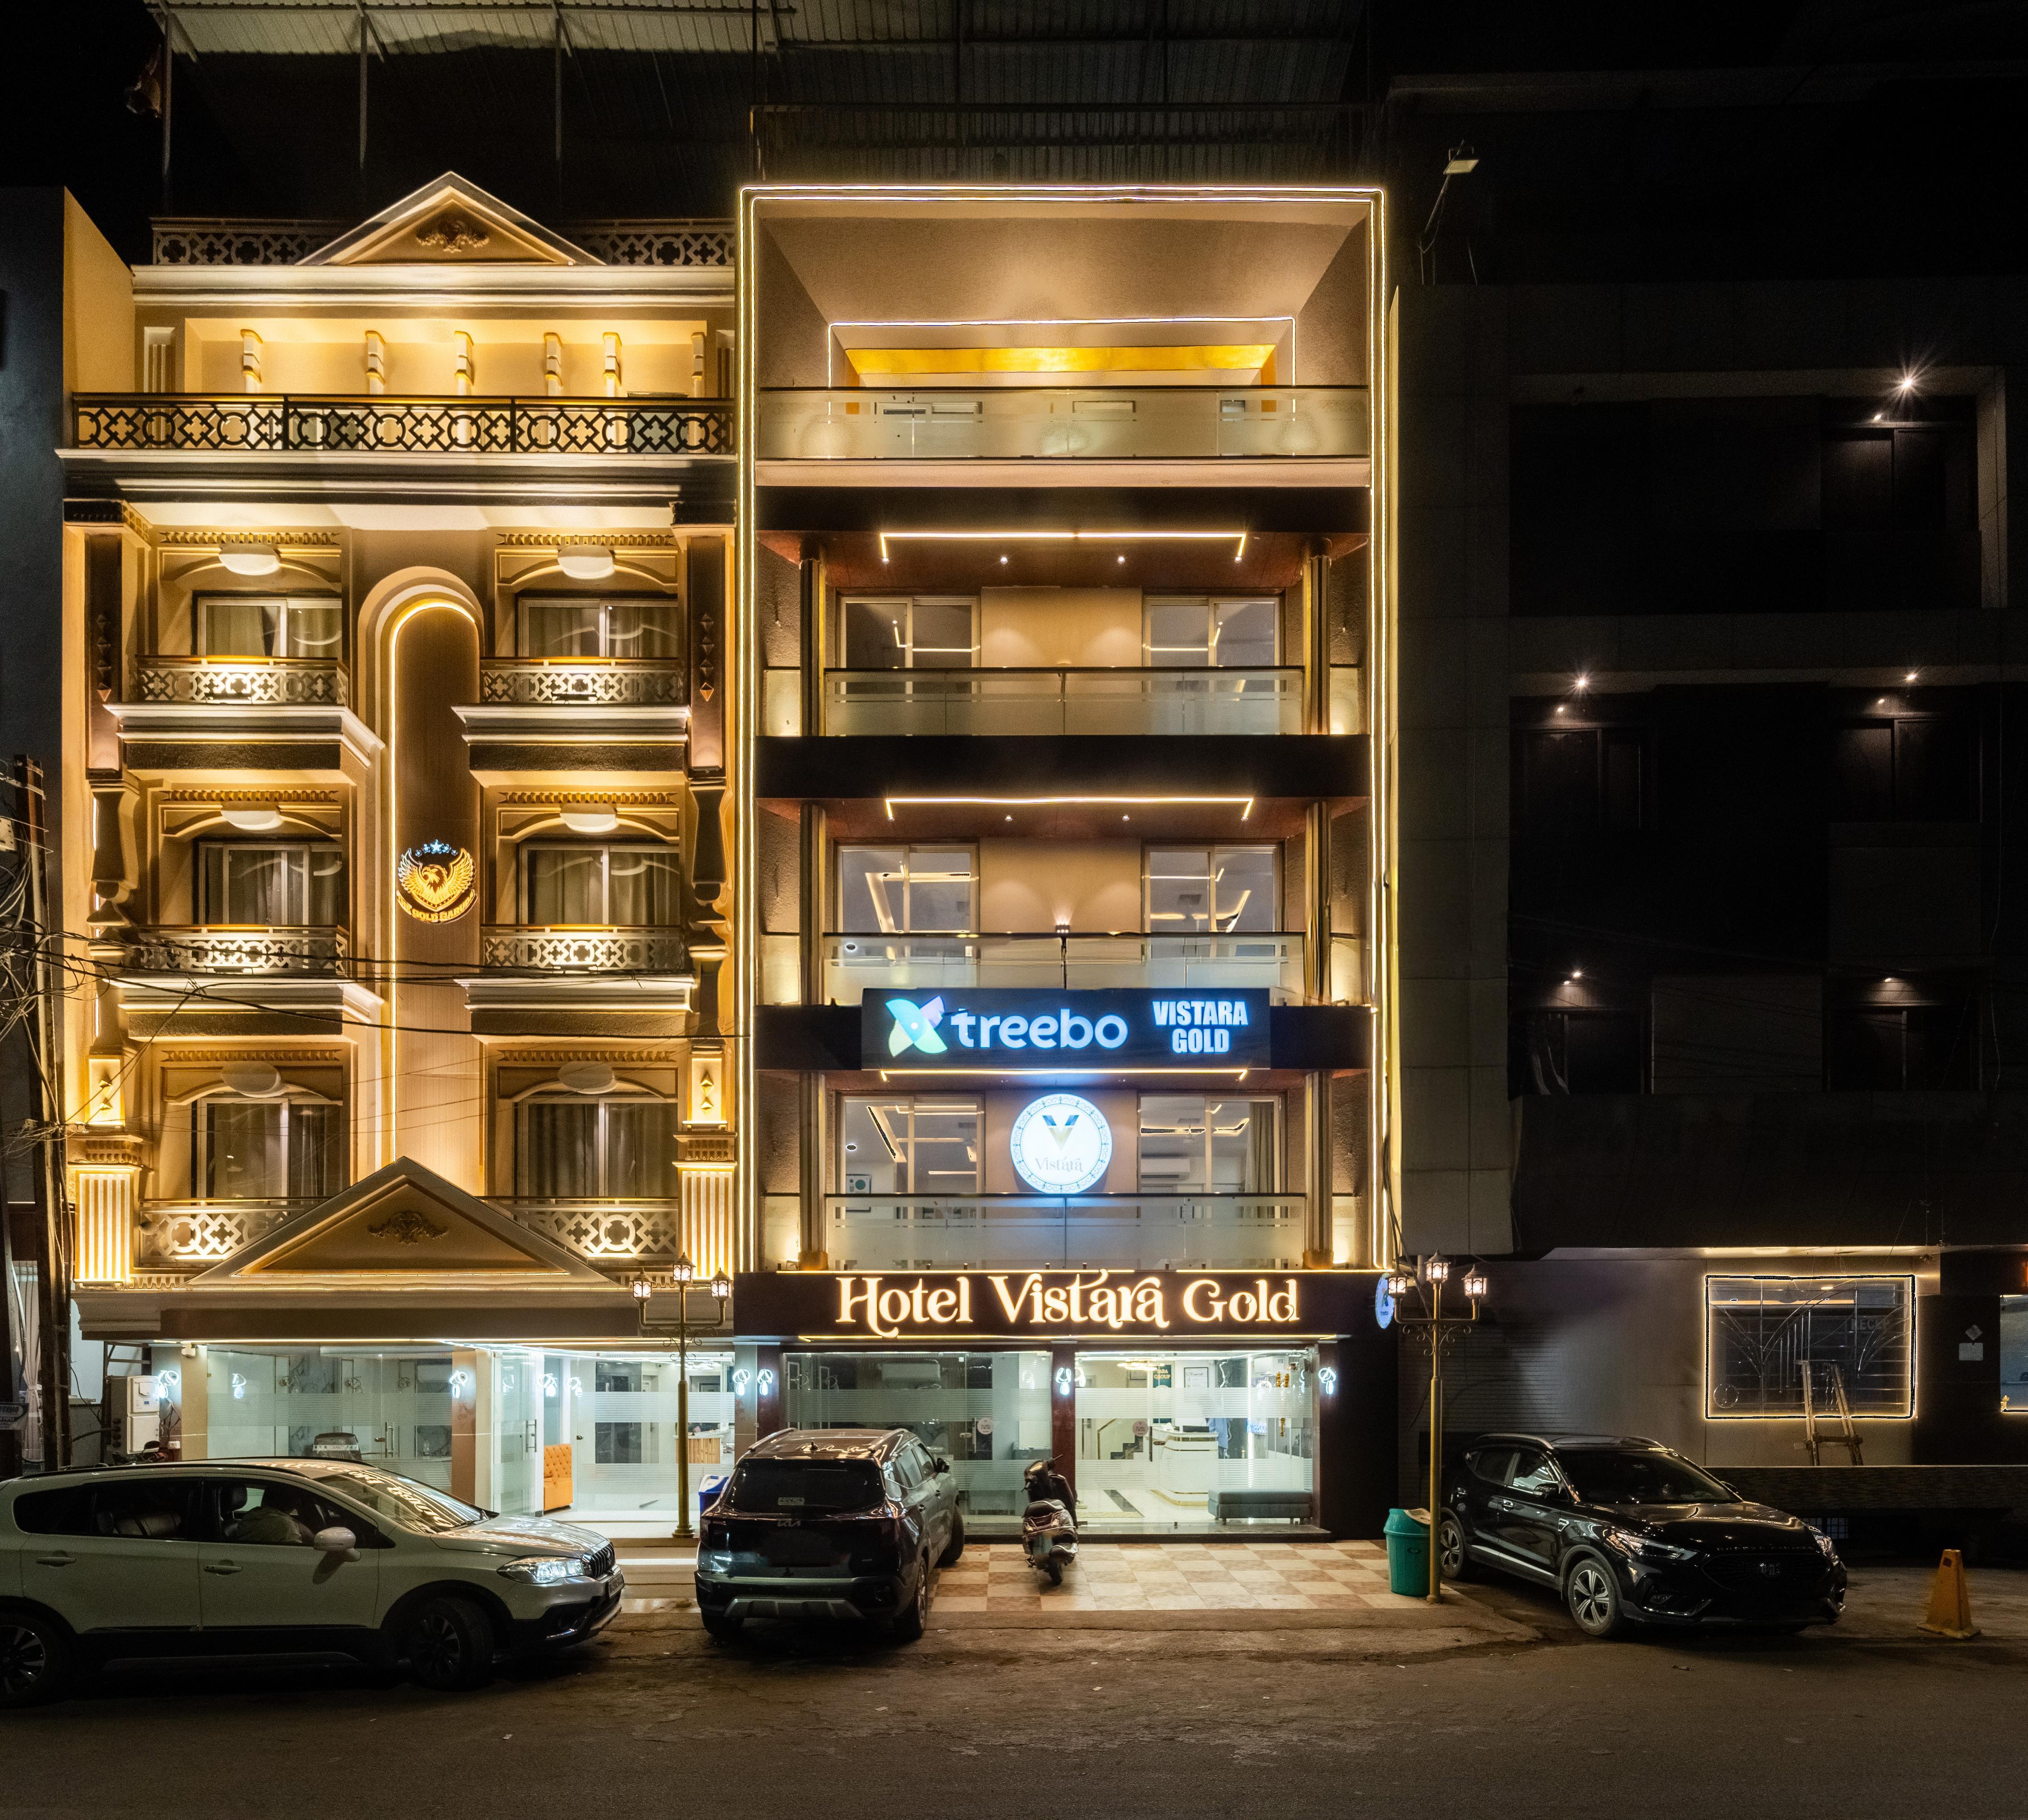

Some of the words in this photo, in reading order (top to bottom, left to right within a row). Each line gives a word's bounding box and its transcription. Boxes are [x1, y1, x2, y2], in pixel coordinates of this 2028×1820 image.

[412, 909, 438, 921] GOLD
[439, 889, 475, 920] GARUDA
[1153, 1001, 1248, 1026] VISTARA
[952, 1008, 1128, 1049] treebo
[1172, 1029, 1230, 1054] GOLD
[1035, 1156, 1083, 1172] Vistara
[836, 1277, 973, 1337] Hotel
[988, 1270, 1169, 1327] Vistara
[1183, 1278, 1300, 1323] Gold
